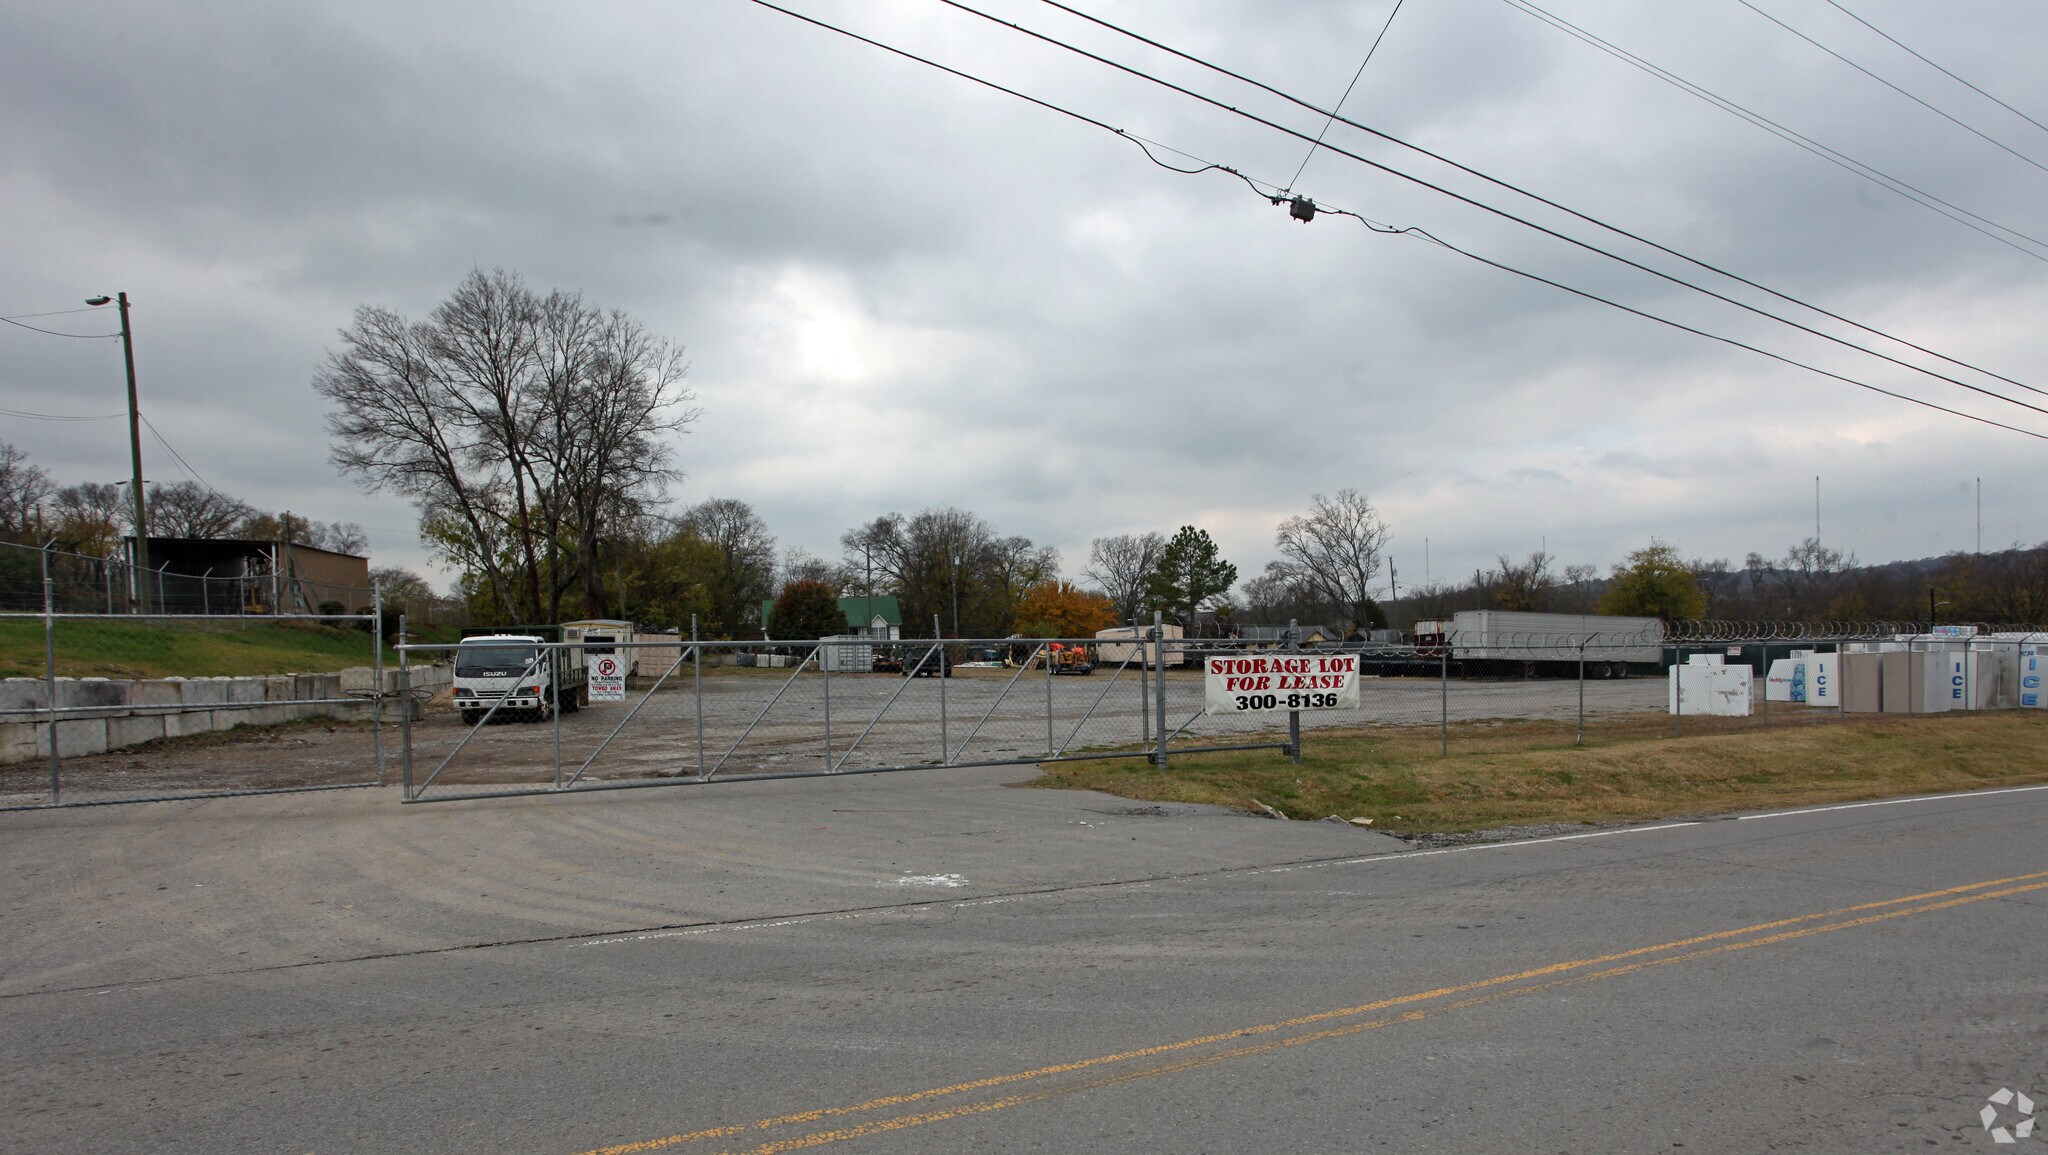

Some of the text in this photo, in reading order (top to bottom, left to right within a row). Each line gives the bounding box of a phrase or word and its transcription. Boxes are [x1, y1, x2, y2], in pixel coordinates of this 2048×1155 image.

[1211, 657, 1355, 675] STORAGE LOT
[1225, 674, 1345, 691] FOR LEASE
[1816, 663, 1827, 697] ICE
[1952, 662, 1963, 699] ICE
[2021, 658, 2040, 706] ICE
[1235, 692, 1338, 710] 300-8136
